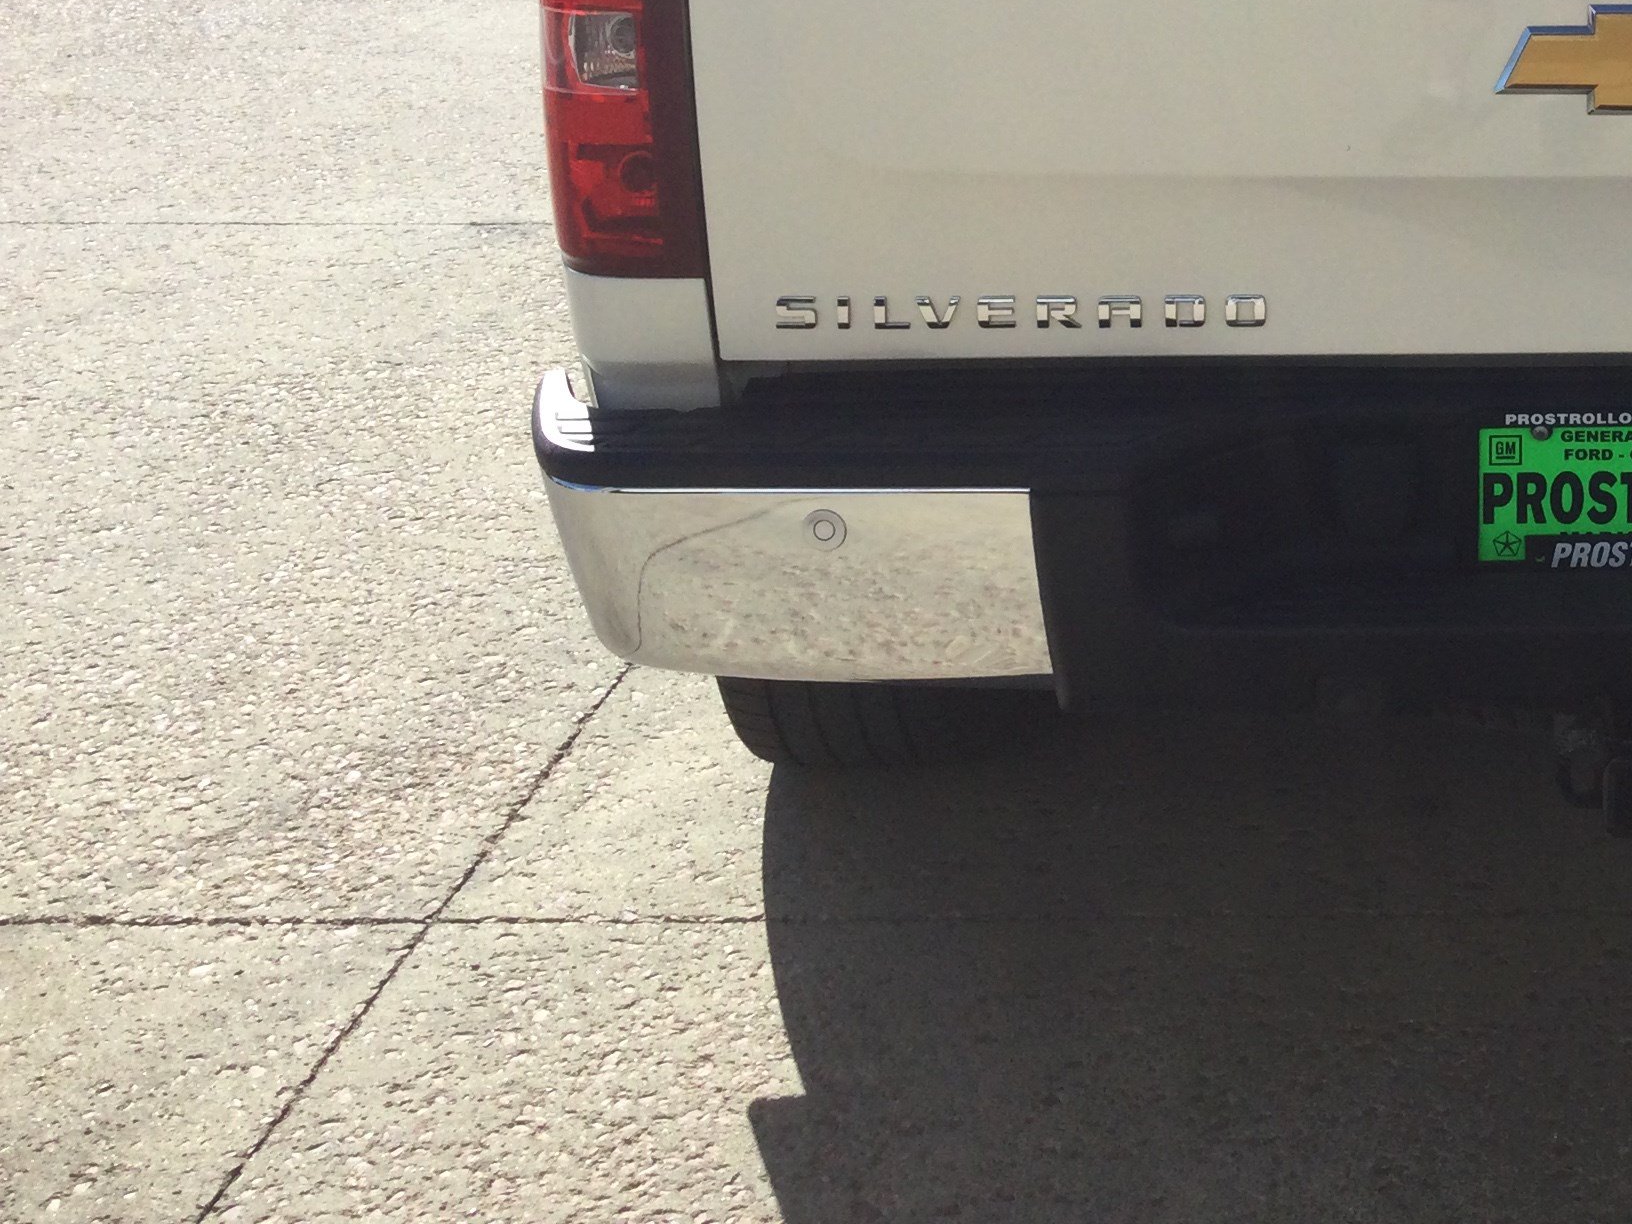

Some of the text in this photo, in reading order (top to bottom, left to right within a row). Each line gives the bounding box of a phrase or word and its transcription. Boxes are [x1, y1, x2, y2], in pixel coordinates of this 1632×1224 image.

[775, 294, 1267, 330] SILVERADO
[1495, 440, 1517, 456] GM
[1563, 448, 1614, 461] FORD
